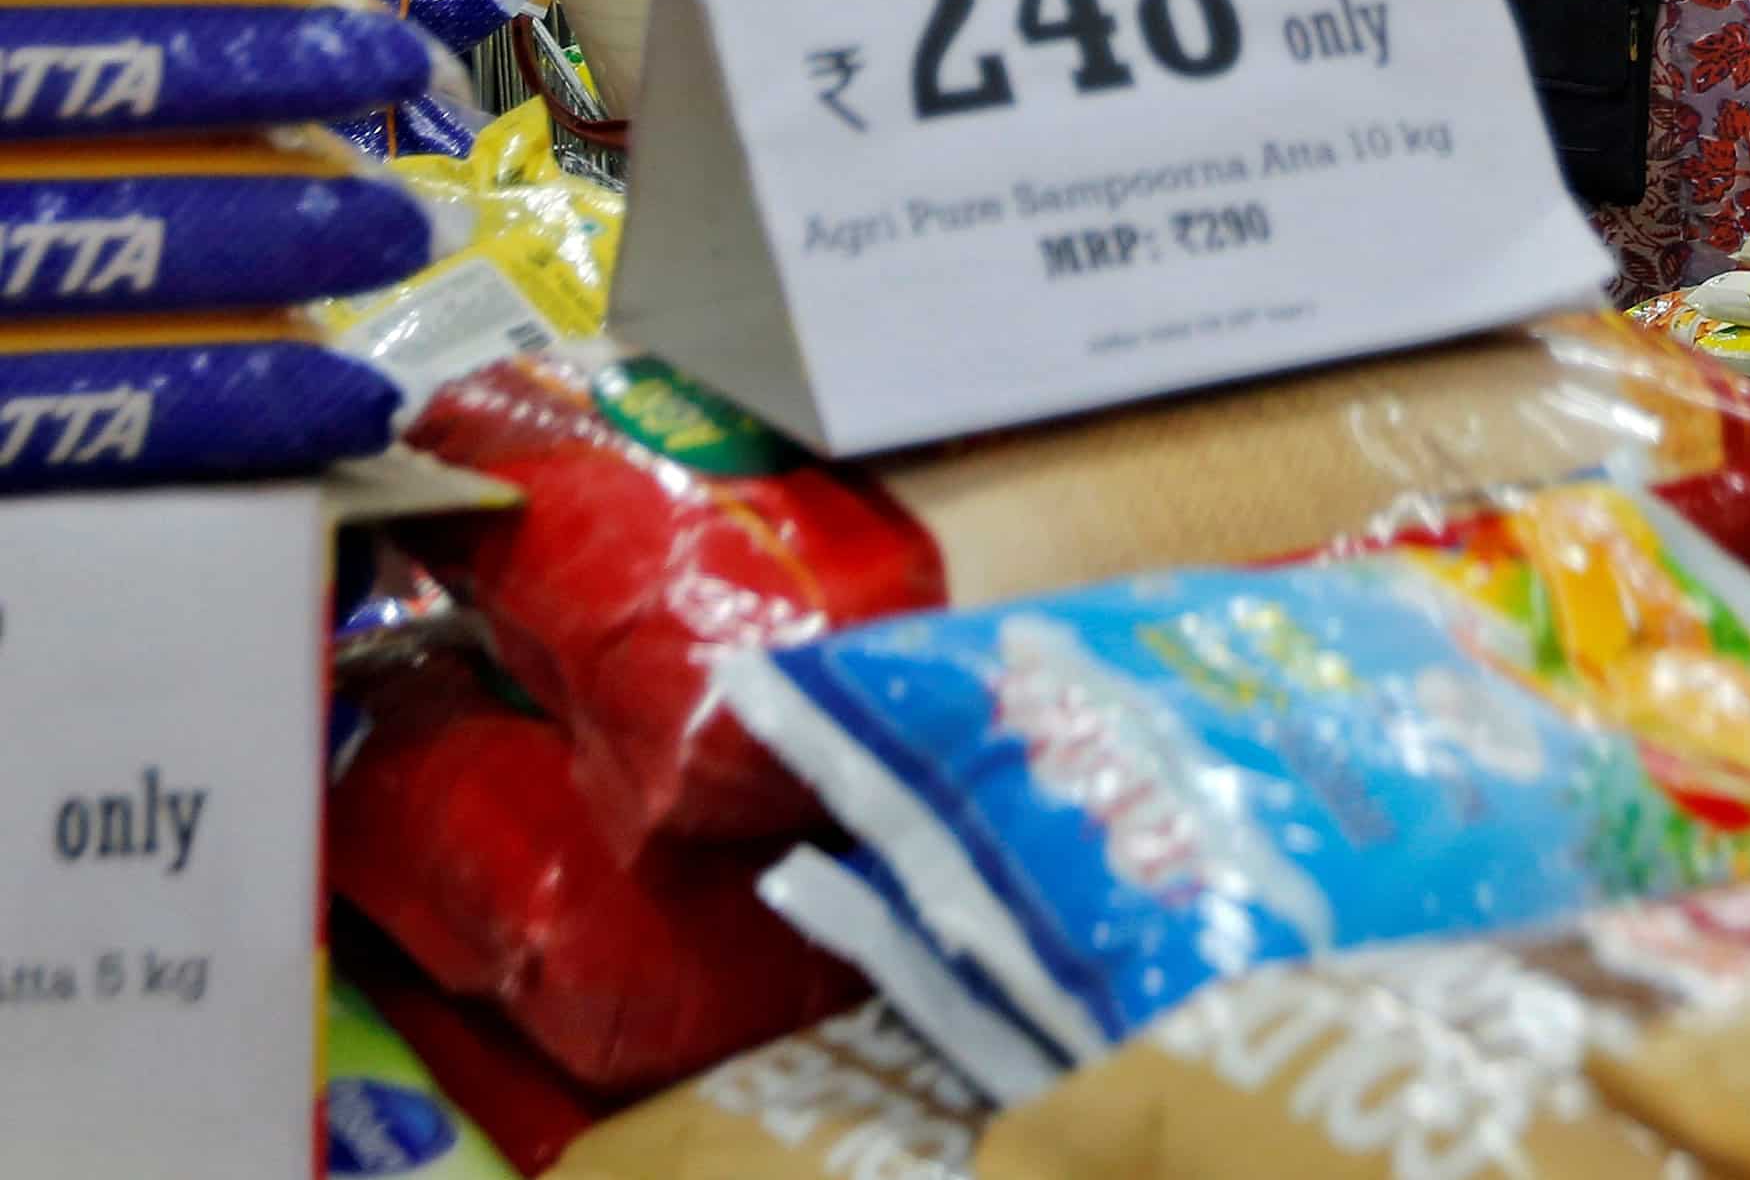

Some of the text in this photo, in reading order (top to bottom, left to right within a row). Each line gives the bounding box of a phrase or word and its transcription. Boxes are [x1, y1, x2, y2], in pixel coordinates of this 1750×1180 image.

[803, 116, 1454, 261] Agri Pure Sampoorna Atta 10 kg
[1037, 199, 1273, 281] MRP: ₹290
[55, 764, 209, 875] only
[140, 951, 210, 1004] kg
